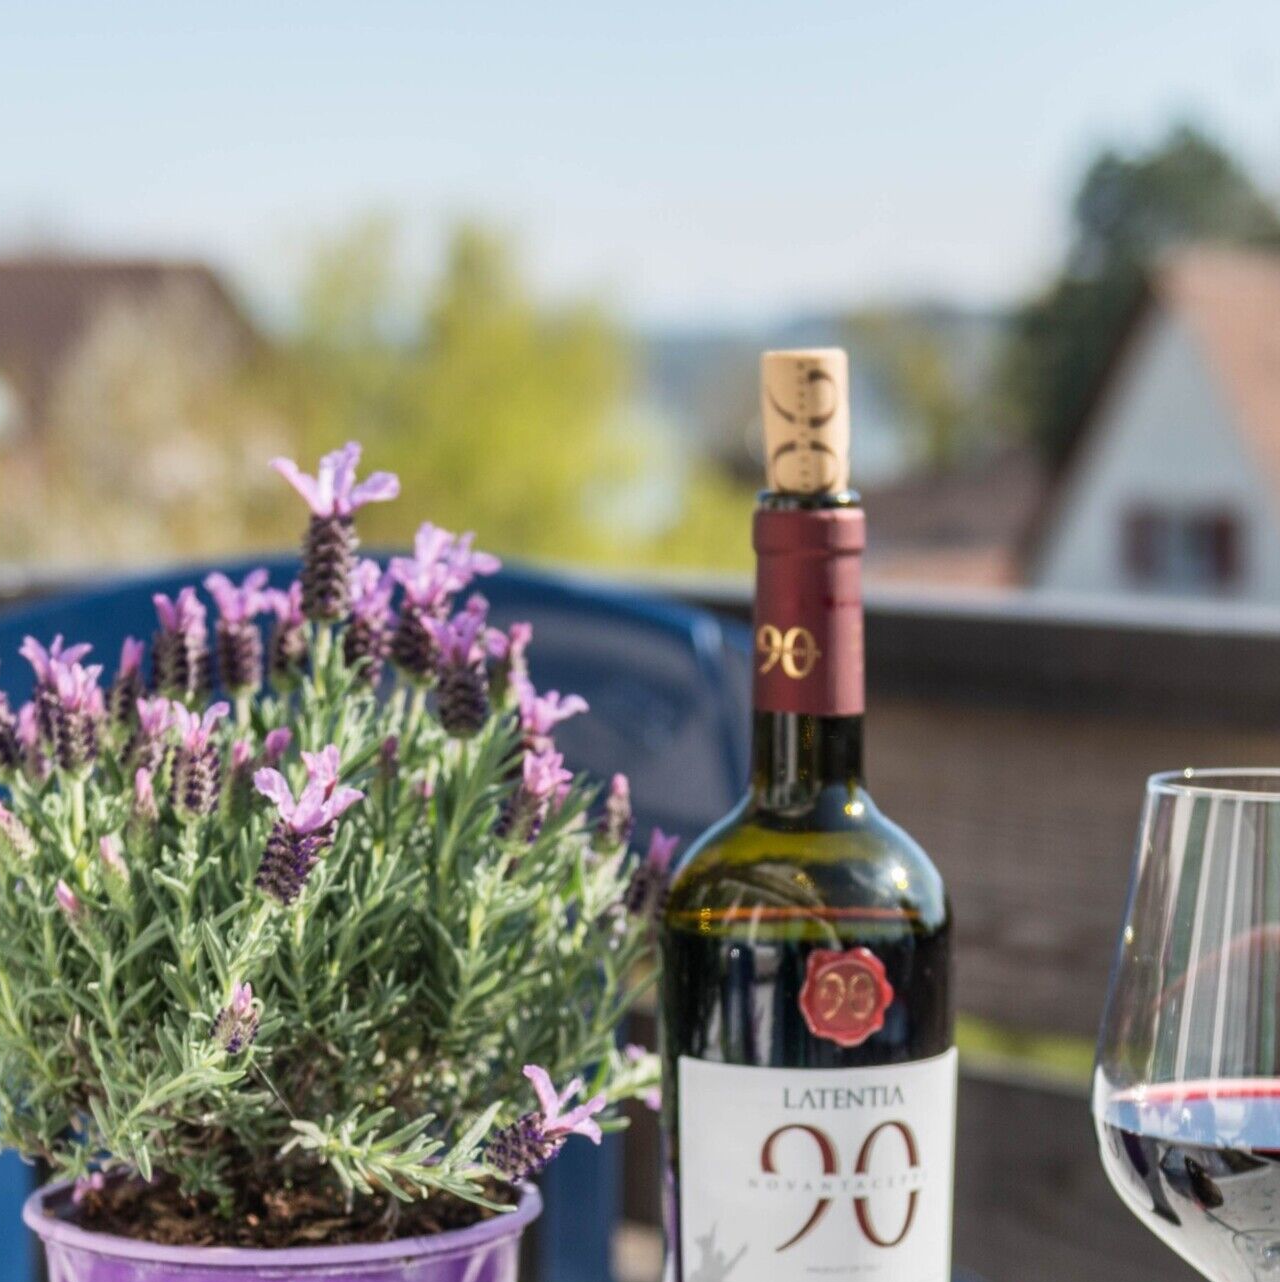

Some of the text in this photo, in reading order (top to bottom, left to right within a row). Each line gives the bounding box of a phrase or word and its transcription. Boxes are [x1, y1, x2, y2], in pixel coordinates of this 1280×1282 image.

[757, 624, 815, 679] 90
[783, 1086, 905, 1109] LATENTIA
[760, 1120, 920, 1252] 90
